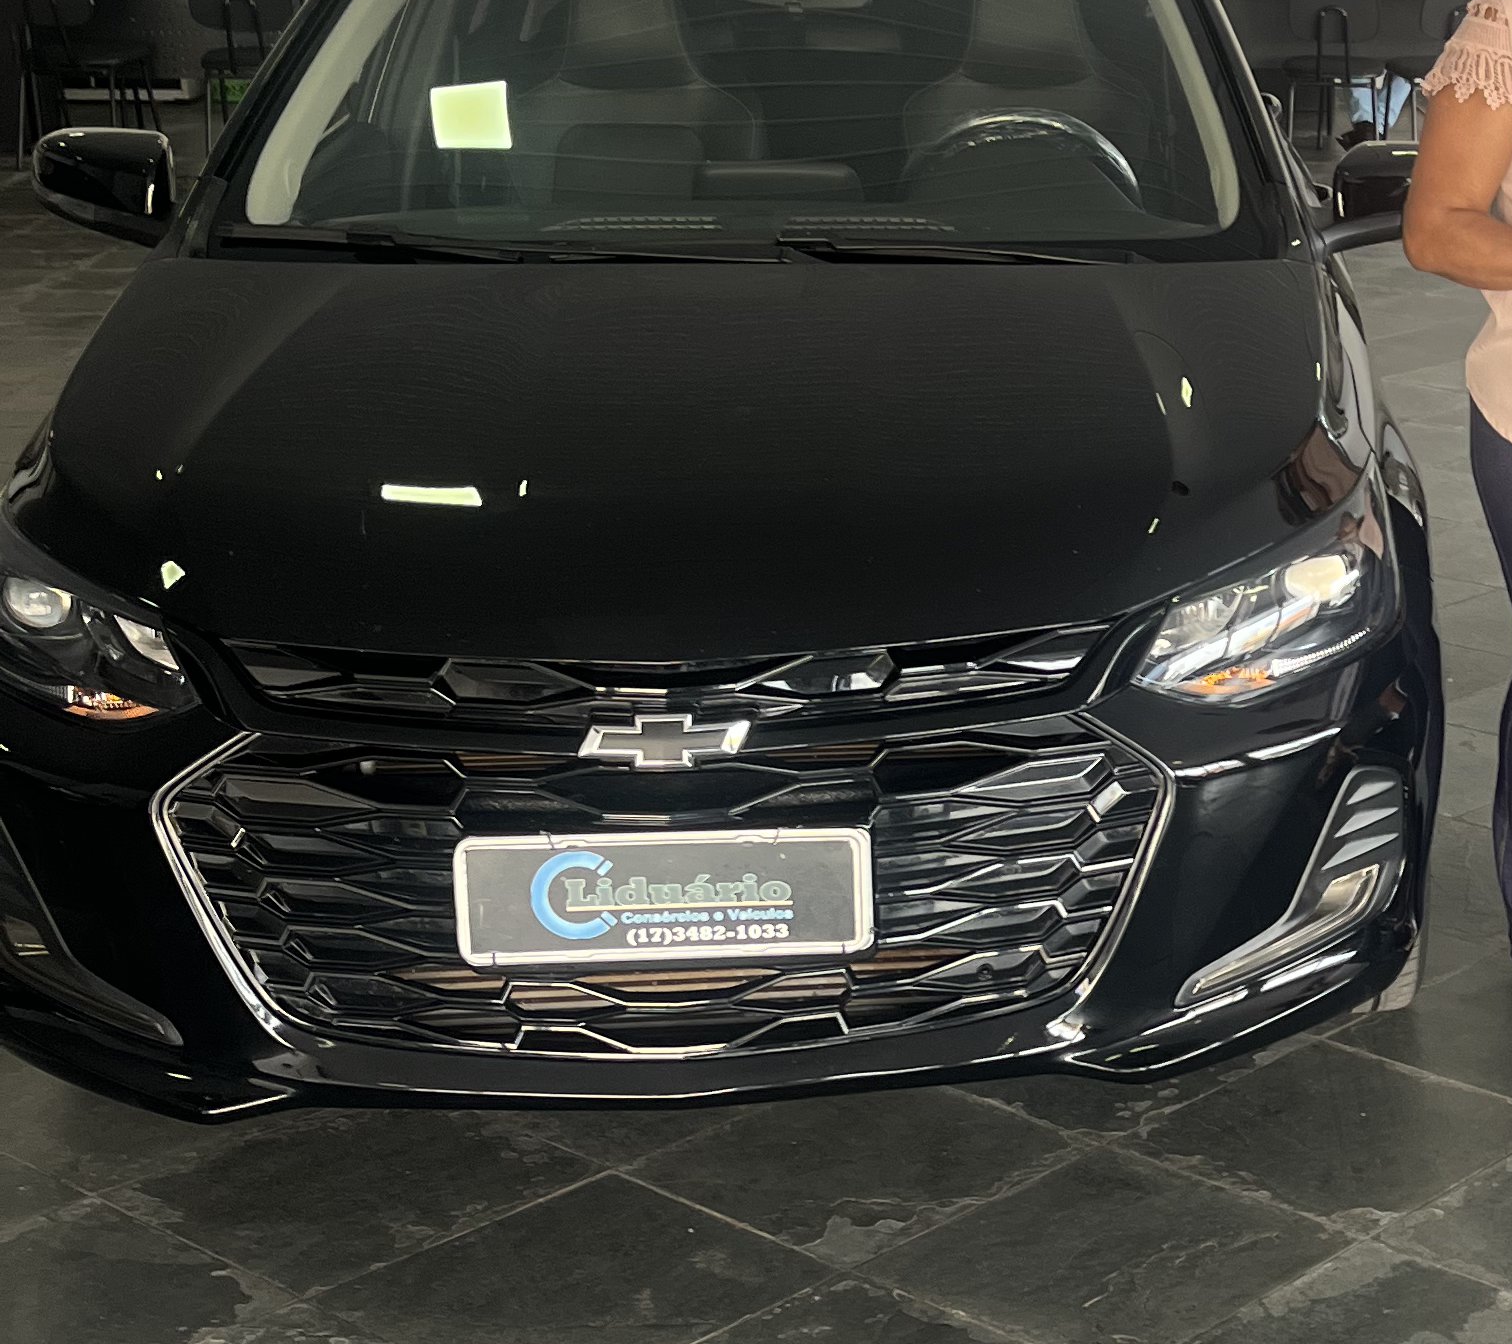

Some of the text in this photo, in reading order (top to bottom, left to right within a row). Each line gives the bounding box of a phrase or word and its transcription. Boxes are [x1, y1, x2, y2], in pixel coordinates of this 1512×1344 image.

[564, 873, 793, 908] Liduário
[620, 908, 794, 926] Consórcios e Veículos
[625, 923, 790, 947] (17)3482-1033
